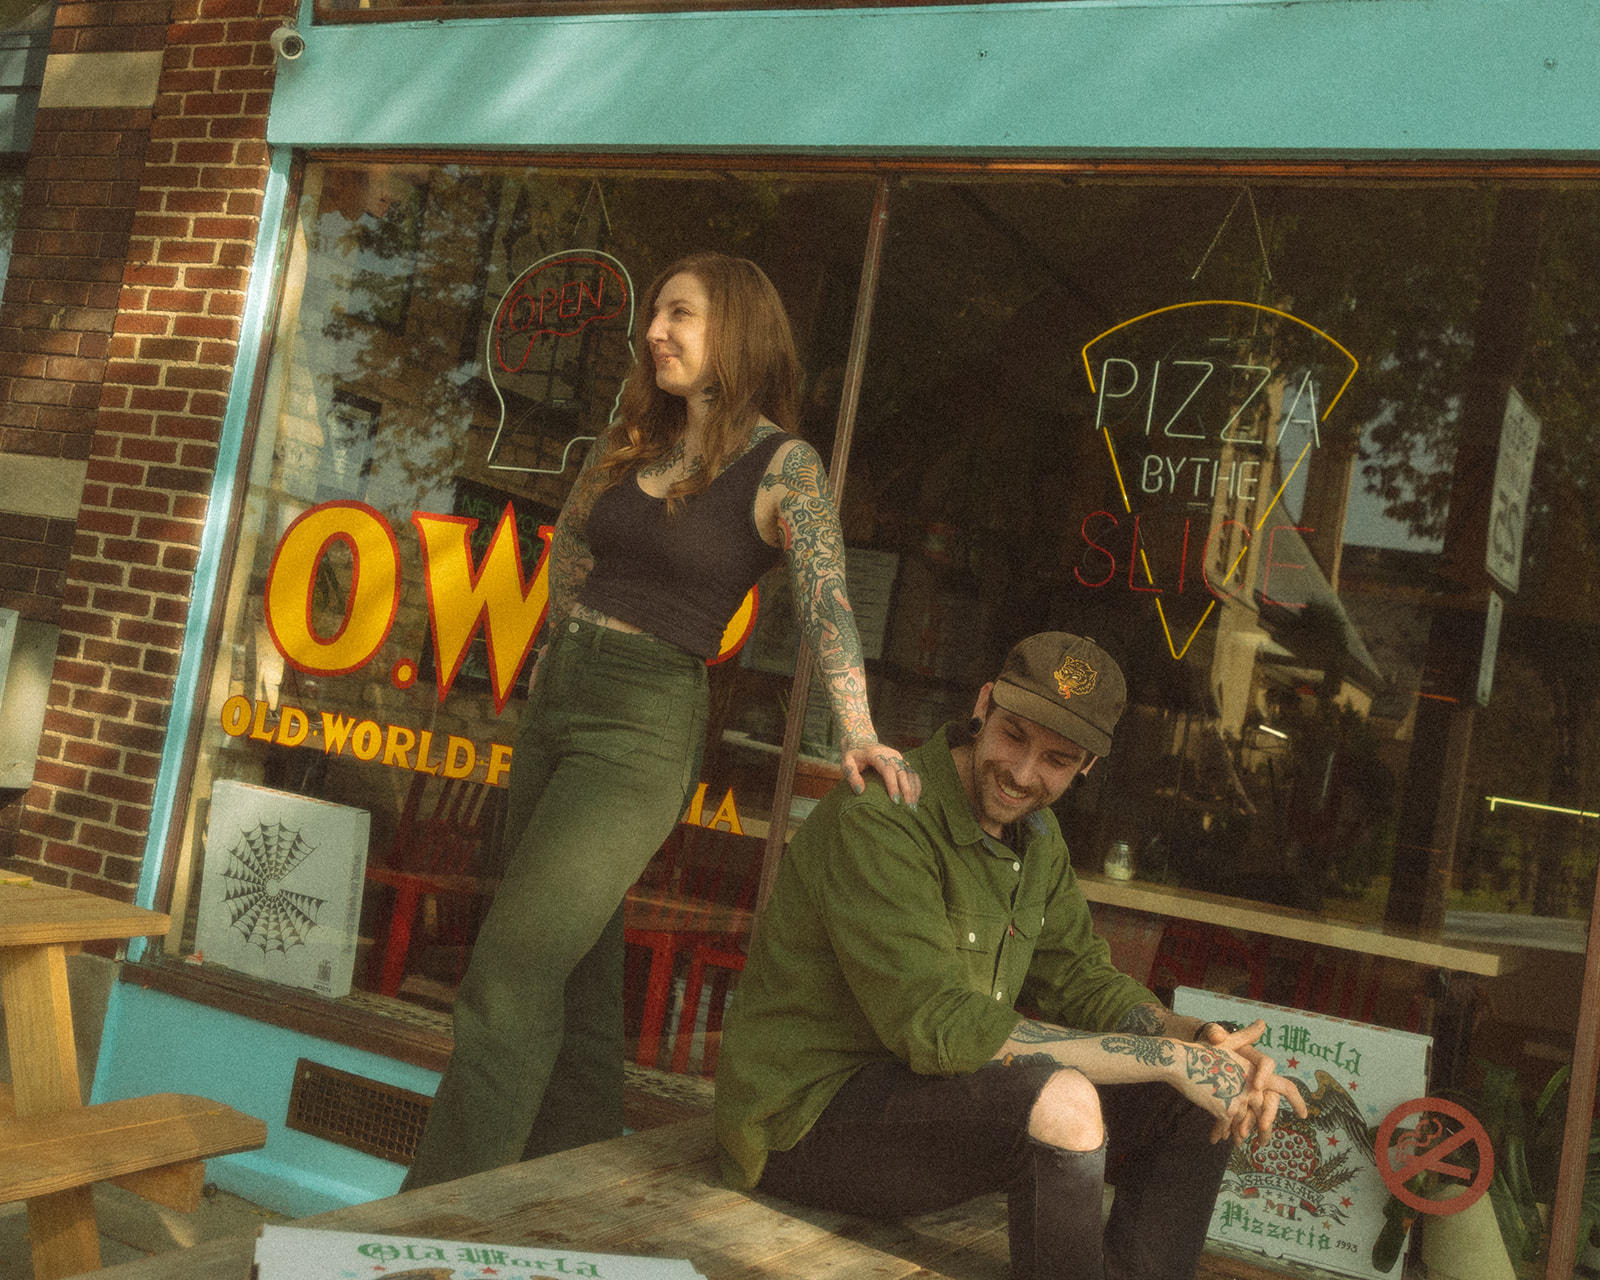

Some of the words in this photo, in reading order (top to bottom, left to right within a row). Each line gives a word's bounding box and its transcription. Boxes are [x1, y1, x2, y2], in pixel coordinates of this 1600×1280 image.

[509, 277, 604, 331] OPEN
[1096, 358, 1320, 448] PIZZA
[1075, 511, 1314, 608] SLICE
[1276, 1024, 1362, 1077] World
[1244, 1174, 1322, 1204] SAGINAW
[1219, 1200, 1332, 1251] Pizzeria
[357, 1242, 445, 1263] Old
[457, 1246, 606, 1279] World
